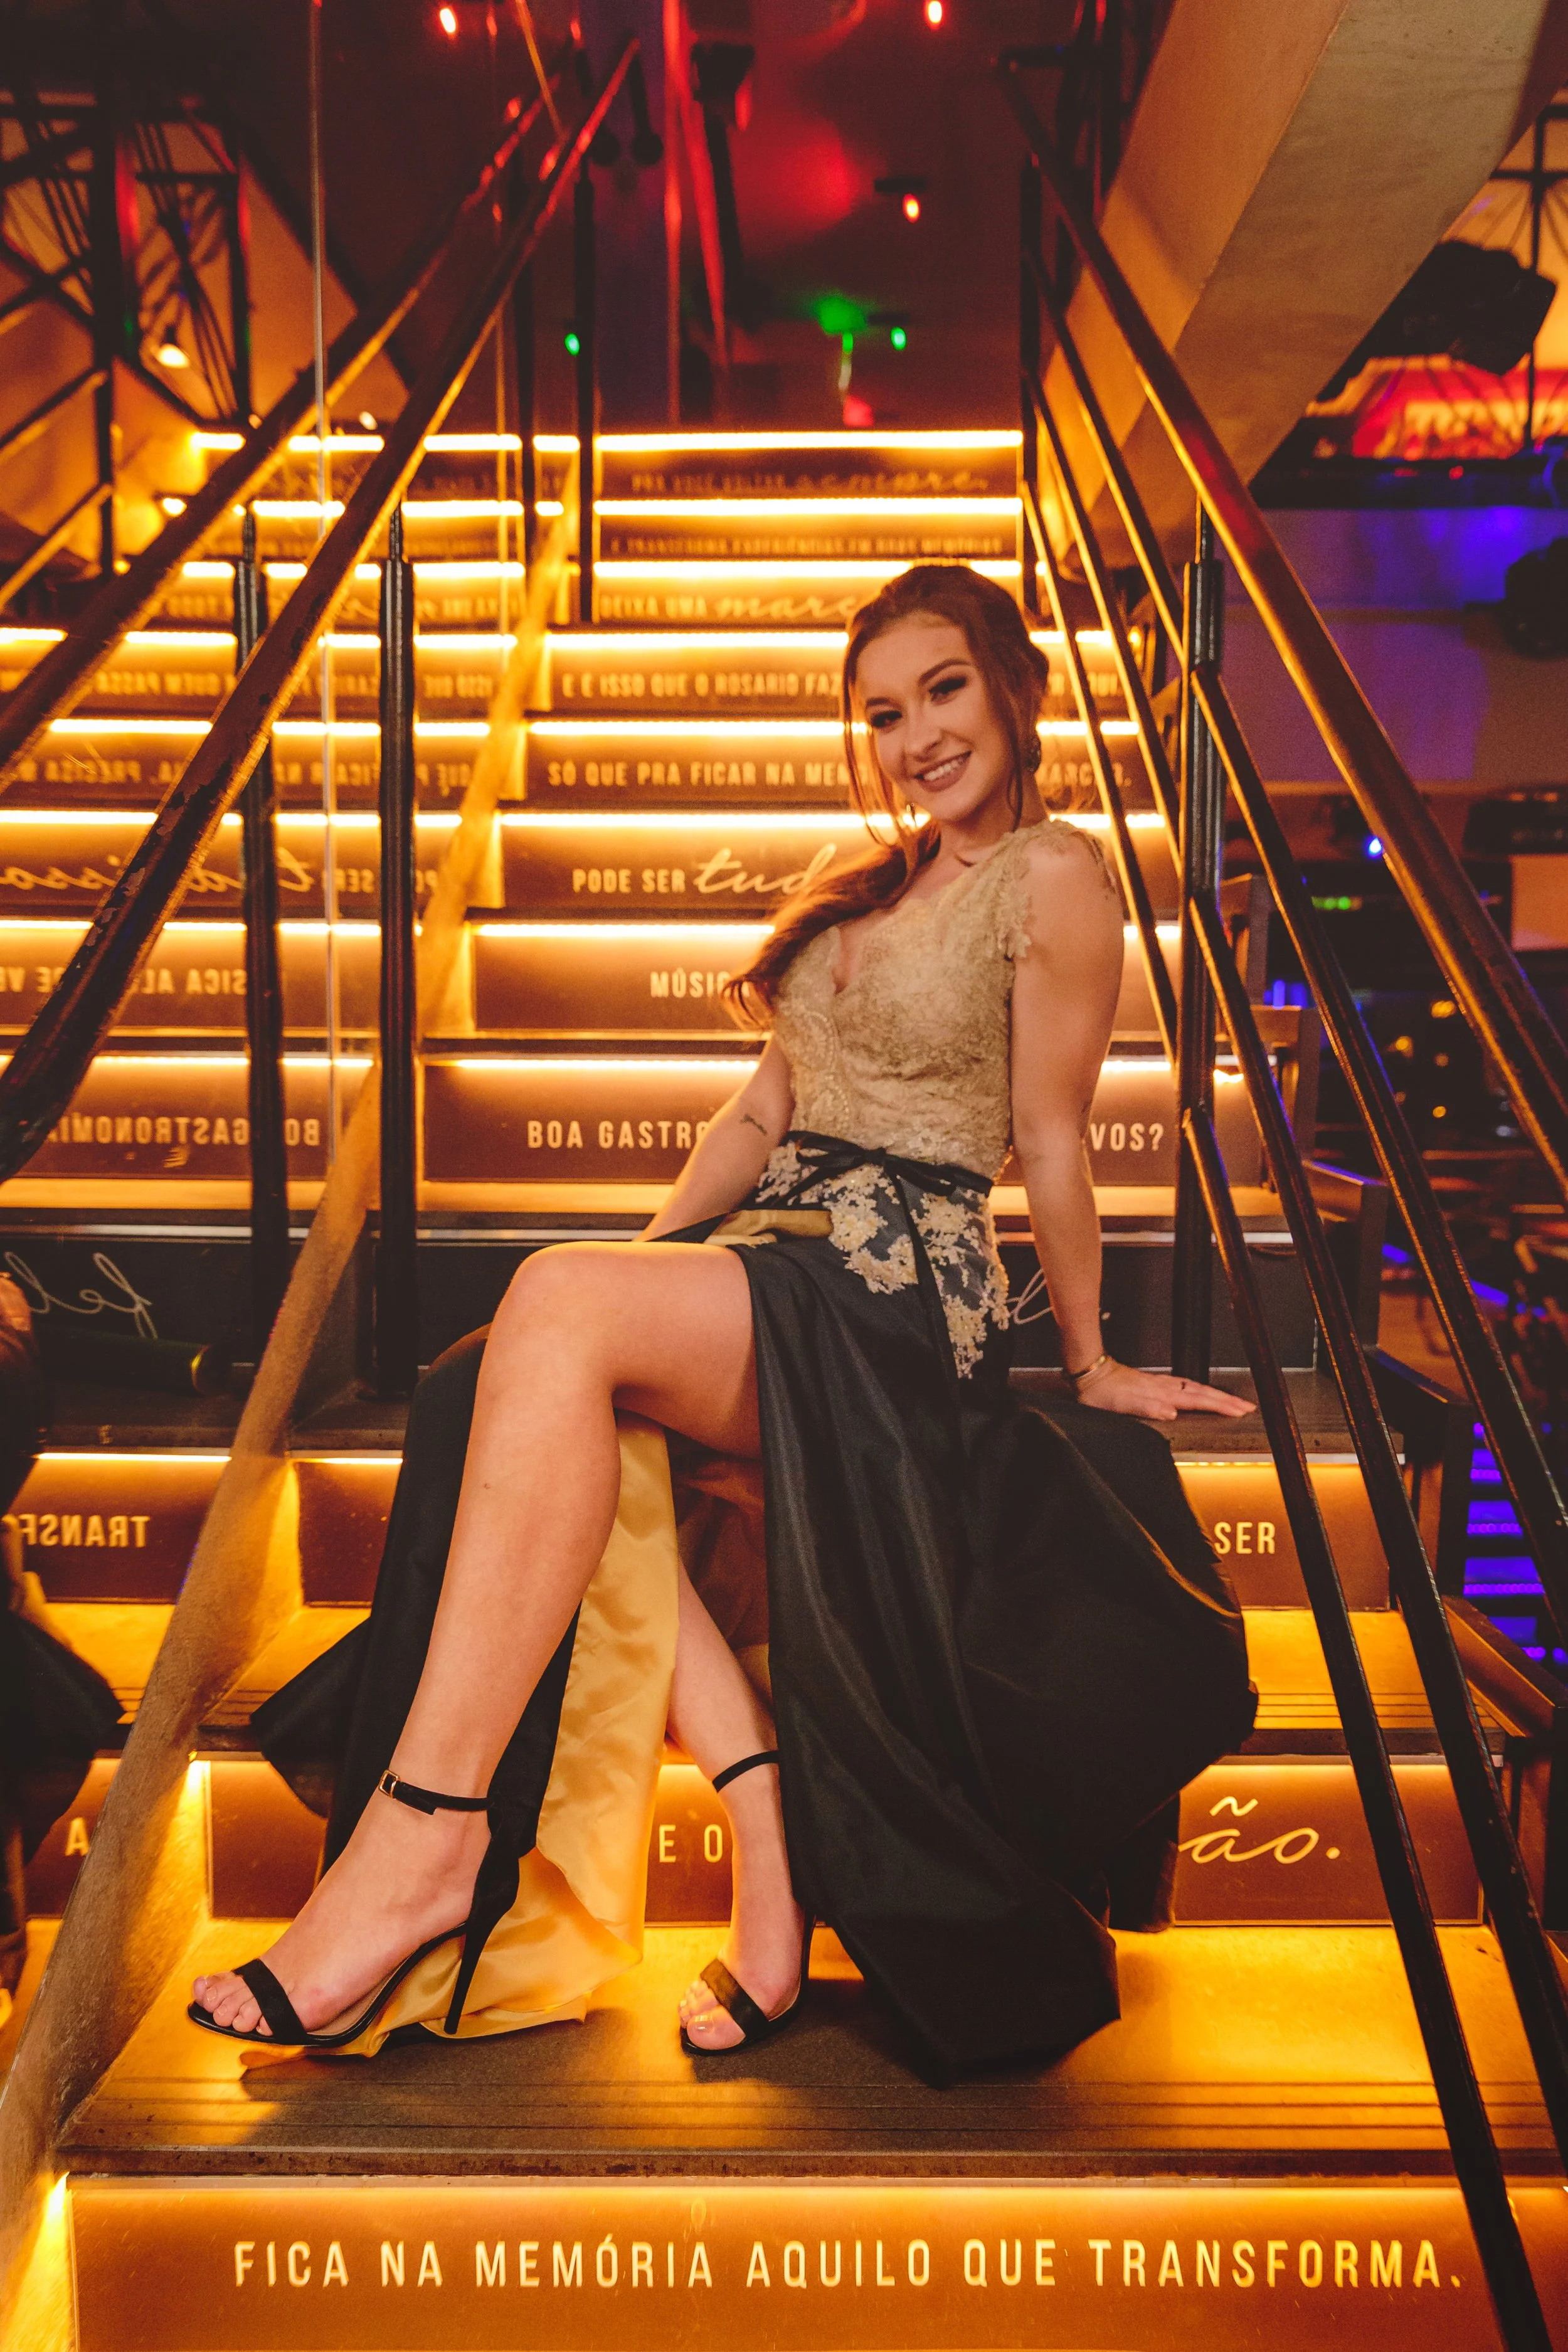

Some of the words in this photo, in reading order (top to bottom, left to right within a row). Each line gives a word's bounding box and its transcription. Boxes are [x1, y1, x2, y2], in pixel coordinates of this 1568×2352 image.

[714, 596, 858, 618] marc
[600, 672, 645, 697] ISSO
[650, 672, 688, 697] QUE
[695, 672, 709, 697] O
[805, 672, 842, 697] FAZ
[585, 761, 627, 787] QUE
[637, 761, 681, 786] PRA
[691, 761, 756, 786] FICAR
[765, 761, 795, 786] NA
[804, 761, 850, 786] MEM
[572, 869, 631, 893] PODE
[642, 869, 686, 893] SER
[692, 843, 837, 895] tud
[650, 967, 751, 999] MÚSIC
[527, 1120, 583, 1149] BOA
[598, 1120, 712, 1149] GASTRO
[1090, 1123, 1164, 1152] VOS?
[1213, 1521, 1276, 1555] SER
[659, 1824, 677, 1863] E
[704, 1823, 723, 1863] O
[1179, 1796, 1340, 1864] ão.
[235, 2241, 349, 2288] FICA
[381, 2241, 443, 2288] NA
[475, 2234, 712, 2289] MEMÓRIA
[746, 2240, 930, 2289] AQUILO
[964, 2239, 1056, 2288] QUE
[1088, 2239, 1461, 2289] TRANSFORMA.
